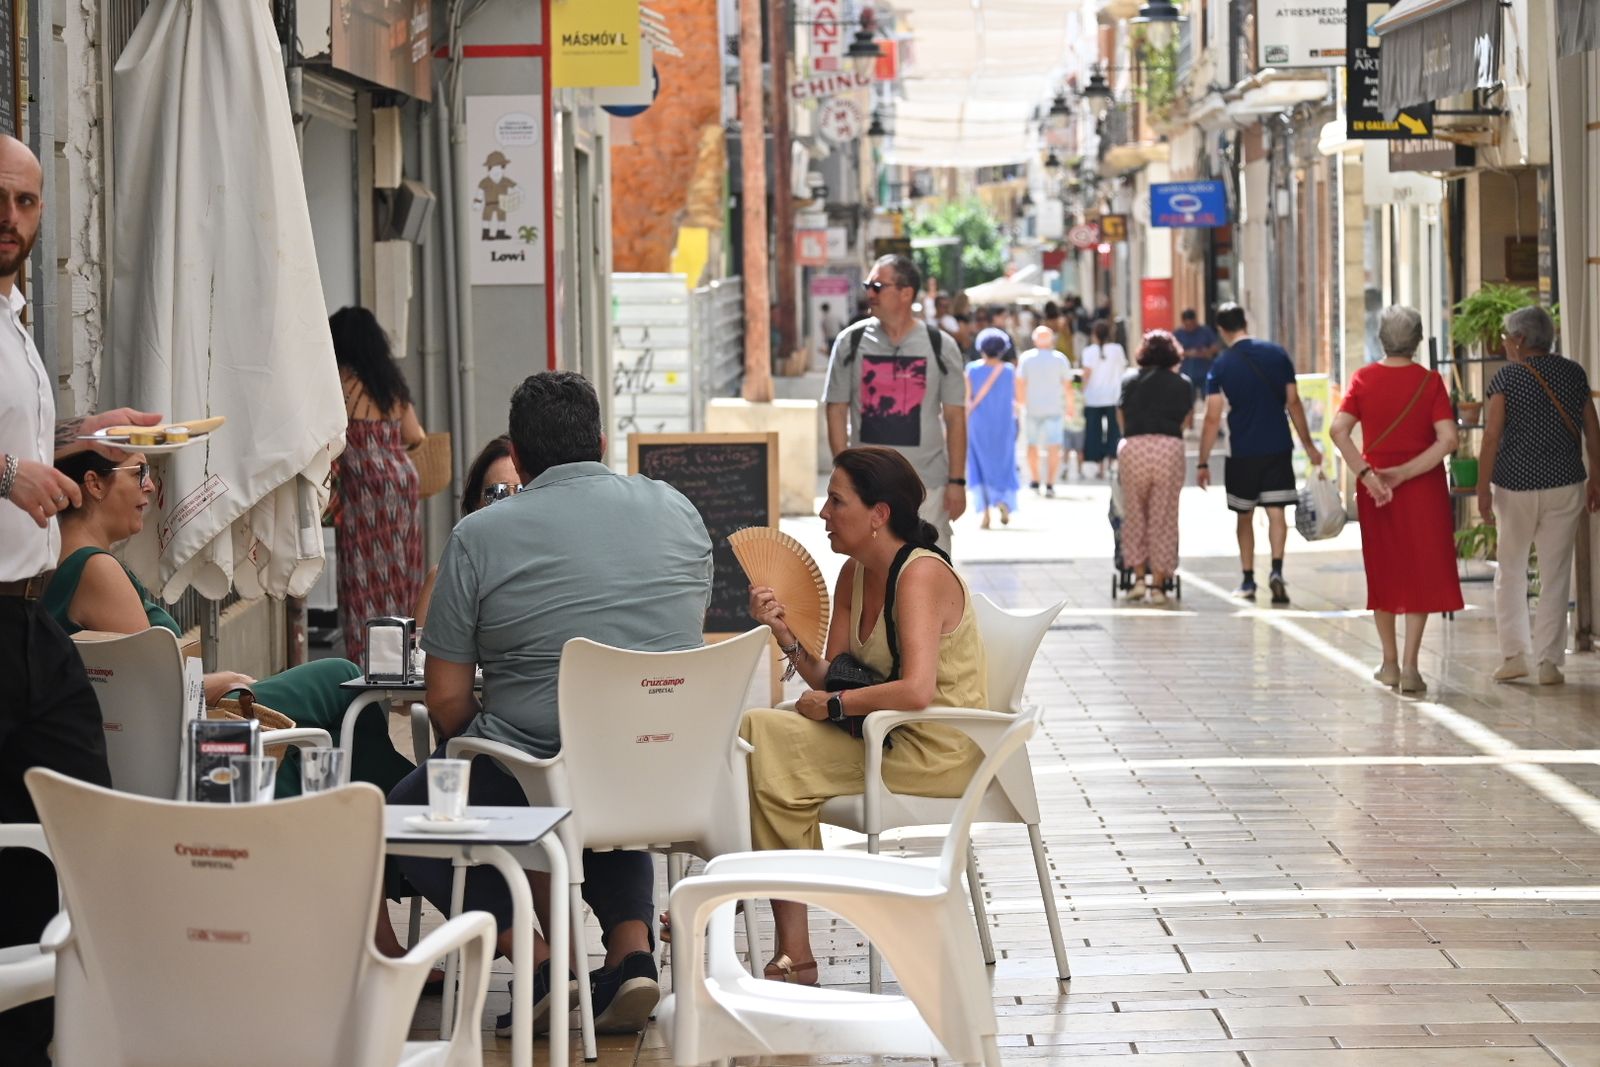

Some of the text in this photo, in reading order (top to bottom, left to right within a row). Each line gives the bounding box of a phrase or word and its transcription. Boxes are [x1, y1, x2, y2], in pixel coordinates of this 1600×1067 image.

[491, 250, 525, 262] Lowi
[641, 678, 685, 687] Cruzcampo
[174, 843, 249, 860] Cruzcampo
